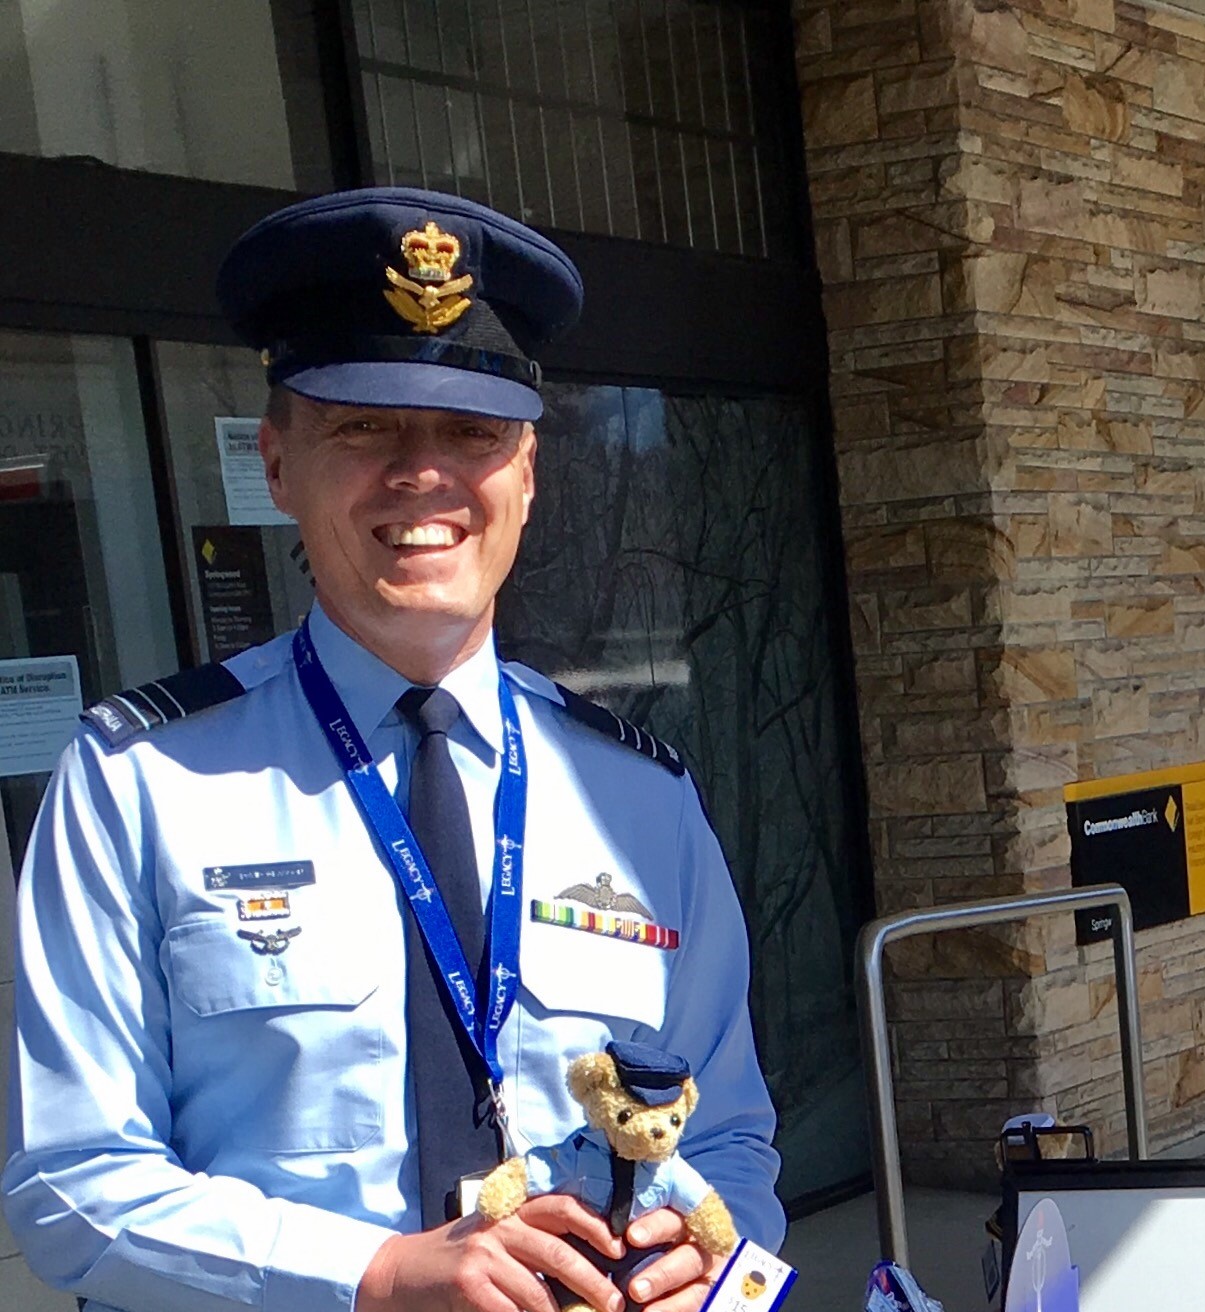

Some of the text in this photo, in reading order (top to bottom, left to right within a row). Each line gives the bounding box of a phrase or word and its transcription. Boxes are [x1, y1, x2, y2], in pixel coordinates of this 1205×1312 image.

[329, 718, 358, 760] LEGACY
[391, 838, 424, 884] LEGACY
[500, 853, 515, 896] LEGACY
[448, 971, 476, 1016] LEGACY
[489, 983, 507, 1031] LEGACY
